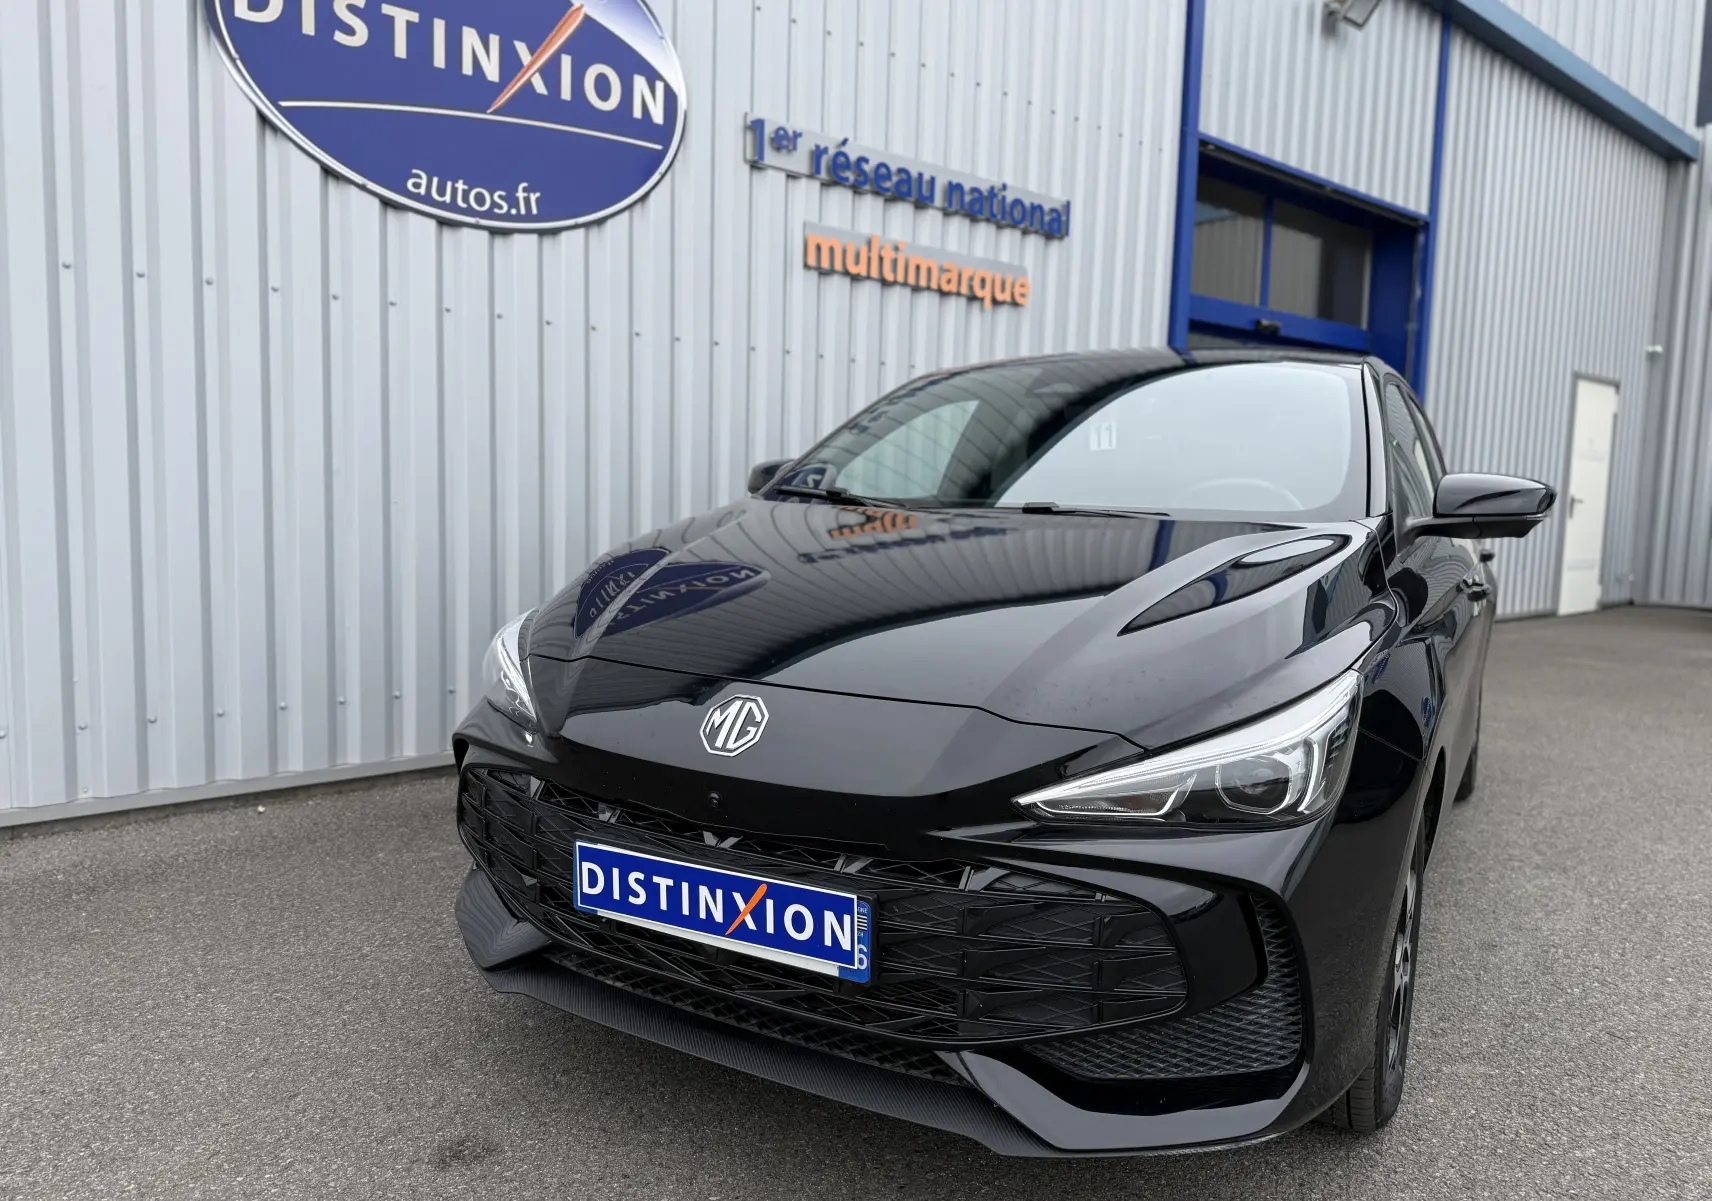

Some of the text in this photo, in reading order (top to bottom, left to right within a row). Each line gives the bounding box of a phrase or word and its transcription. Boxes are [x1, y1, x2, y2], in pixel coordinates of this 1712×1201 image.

[406, 169, 540, 215] autos.fr
[751, 117, 1071, 237] 1er réseau national
[805, 233, 1030, 308] multimarque
[703, 699, 763, 750] MG
[580, 861, 852, 951] DISTINXION
